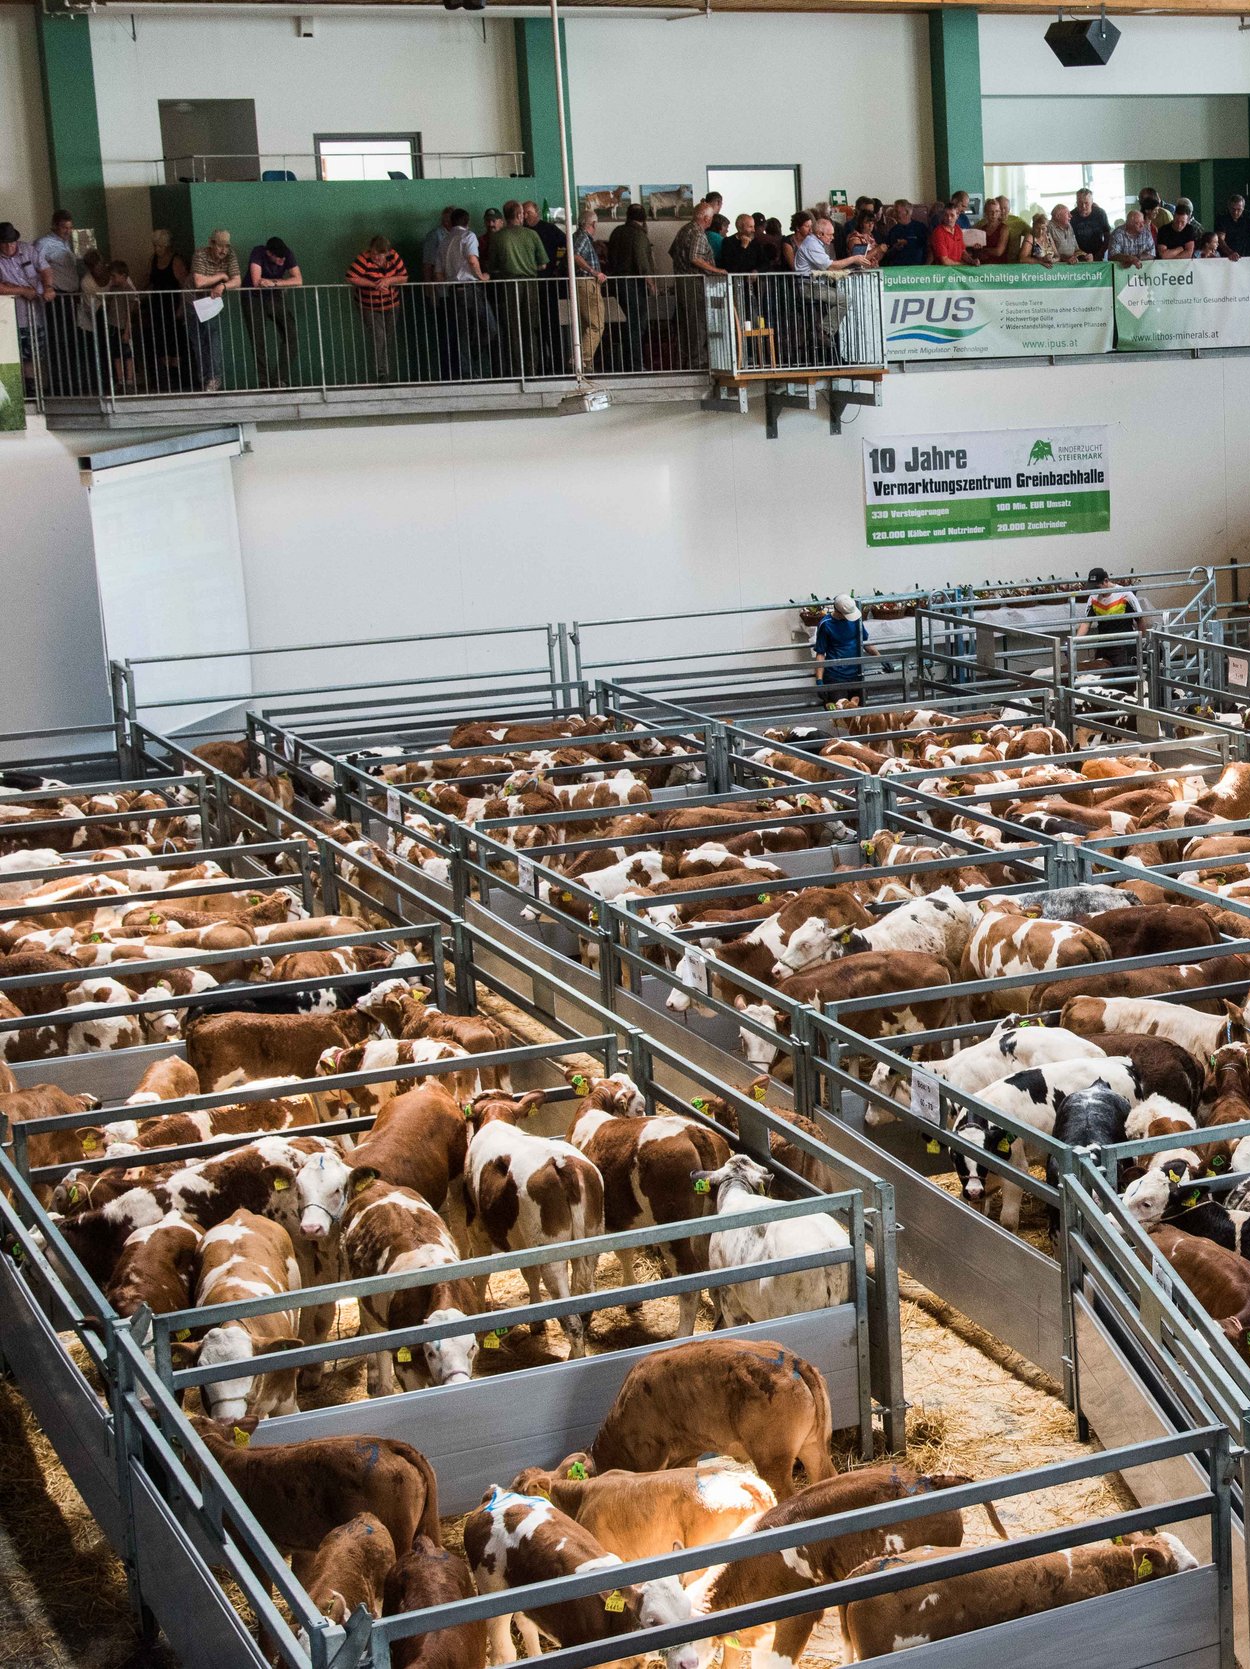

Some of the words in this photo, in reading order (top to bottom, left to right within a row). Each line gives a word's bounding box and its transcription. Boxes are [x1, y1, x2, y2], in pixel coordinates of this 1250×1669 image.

[884, 275, 930, 286] igulatoren
[932, 274, 945, 283] für
[948, 274, 966, 283] eine
[968, 272, 1018, 284] nachhaltige
[1022, 272, 1102, 281] Kreislaufwirtschaft
[1127, 271, 1193, 287] LithoFeed
[890, 297, 976, 324] IPUS
[1132, 330, 1218, 341] www.lithos-minerals.at
[1022, 339, 1077, 350] www.ipus.at
[1058, 444, 1102, 453] RINDERZUCHT
[869, 448, 896, 473] 10
[905, 446, 967, 472] Jahre
[1058, 453, 1103, 461] STEIERMARK
[873, 475, 1012, 496] Vermarktungszentrum
[1016, 469, 1104, 488] Greinbachhalle
[1030, 501, 1044, 509] EUR
[1046, 499, 1072, 508] Umsatz
[890, 508, 949, 518] Versteigerungen
[1027, 520, 1067, 529] Zuchtrinder
[933, 528, 946, 536] und
[948, 526, 986, 535] Nutzrinder
